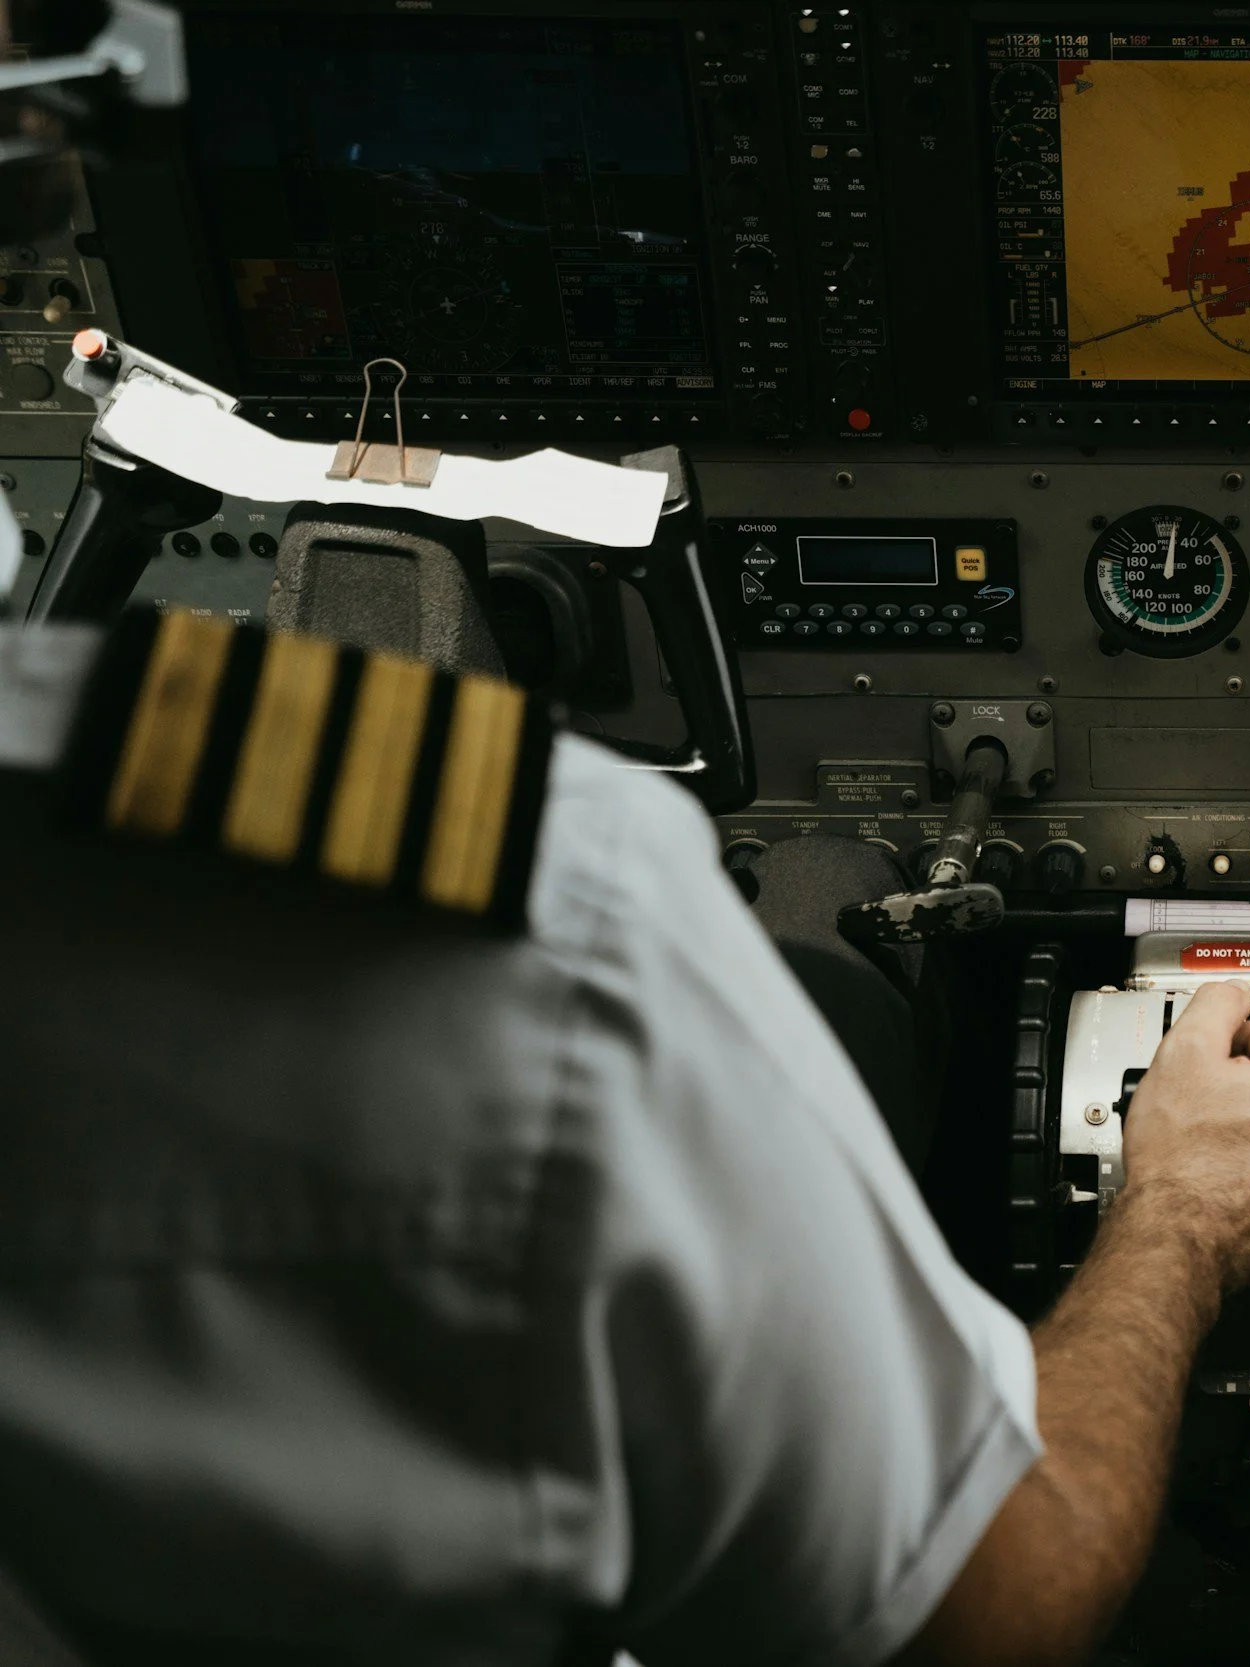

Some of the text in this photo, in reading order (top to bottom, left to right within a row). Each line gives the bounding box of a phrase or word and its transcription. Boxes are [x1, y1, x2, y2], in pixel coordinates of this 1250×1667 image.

[1007, 35, 1088, 46] 112.20 113.40
[1113, 37, 1128, 45] DTK
[1231, 38, 1246, 46] ETA
[1007, 48, 1088, 58] 112.20 113.40
[723, 74, 747, 83] COM
[914, 75, 935, 84] NAV
[1033, 107, 1057, 120] 228
[730, 155, 758, 165] BARO
[1041, 153, 1059, 163] 588
[1040, 191, 1062, 200] 65.6
[736, 234, 770, 243] RANGE
[749, 296, 769, 304] PAN
[767, 316, 787, 324] MENU
[603, 377, 713, 386] TMR/REF NRST ADVISORY
[1009, 381, 1037, 389] ENGINE
[738, 524, 777, 533] ACH1000
[1180, 537, 1198, 548] 40
[1131, 542, 1157, 554] 200
[1126, 556, 1148, 567] 180
[1194, 555, 1212, 566] 60
[1125, 570, 1145, 581] 160
[1132, 588, 1153, 599] 140
[1193, 584, 1211, 595] 80
[1145, 602, 1167, 613] 120
[1172, 603, 1193, 614] 100
[785, 609, 958, 617] 1 2 3 4 5 6
[764, 625, 976, 633] CLR 7 8 9 0 #
[972, 706, 1000, 715] LOCK
[878, 812, 904, 820] DIMMING
[792, 821, 820, 829] STANDBY
[988, 822, 1002, 830] LEFT
[1049, 822, 1066, 830] RIGHT
[1196, 949, 1233, 958] DO NOT
[1216, 1384, 1224, 1393] L
